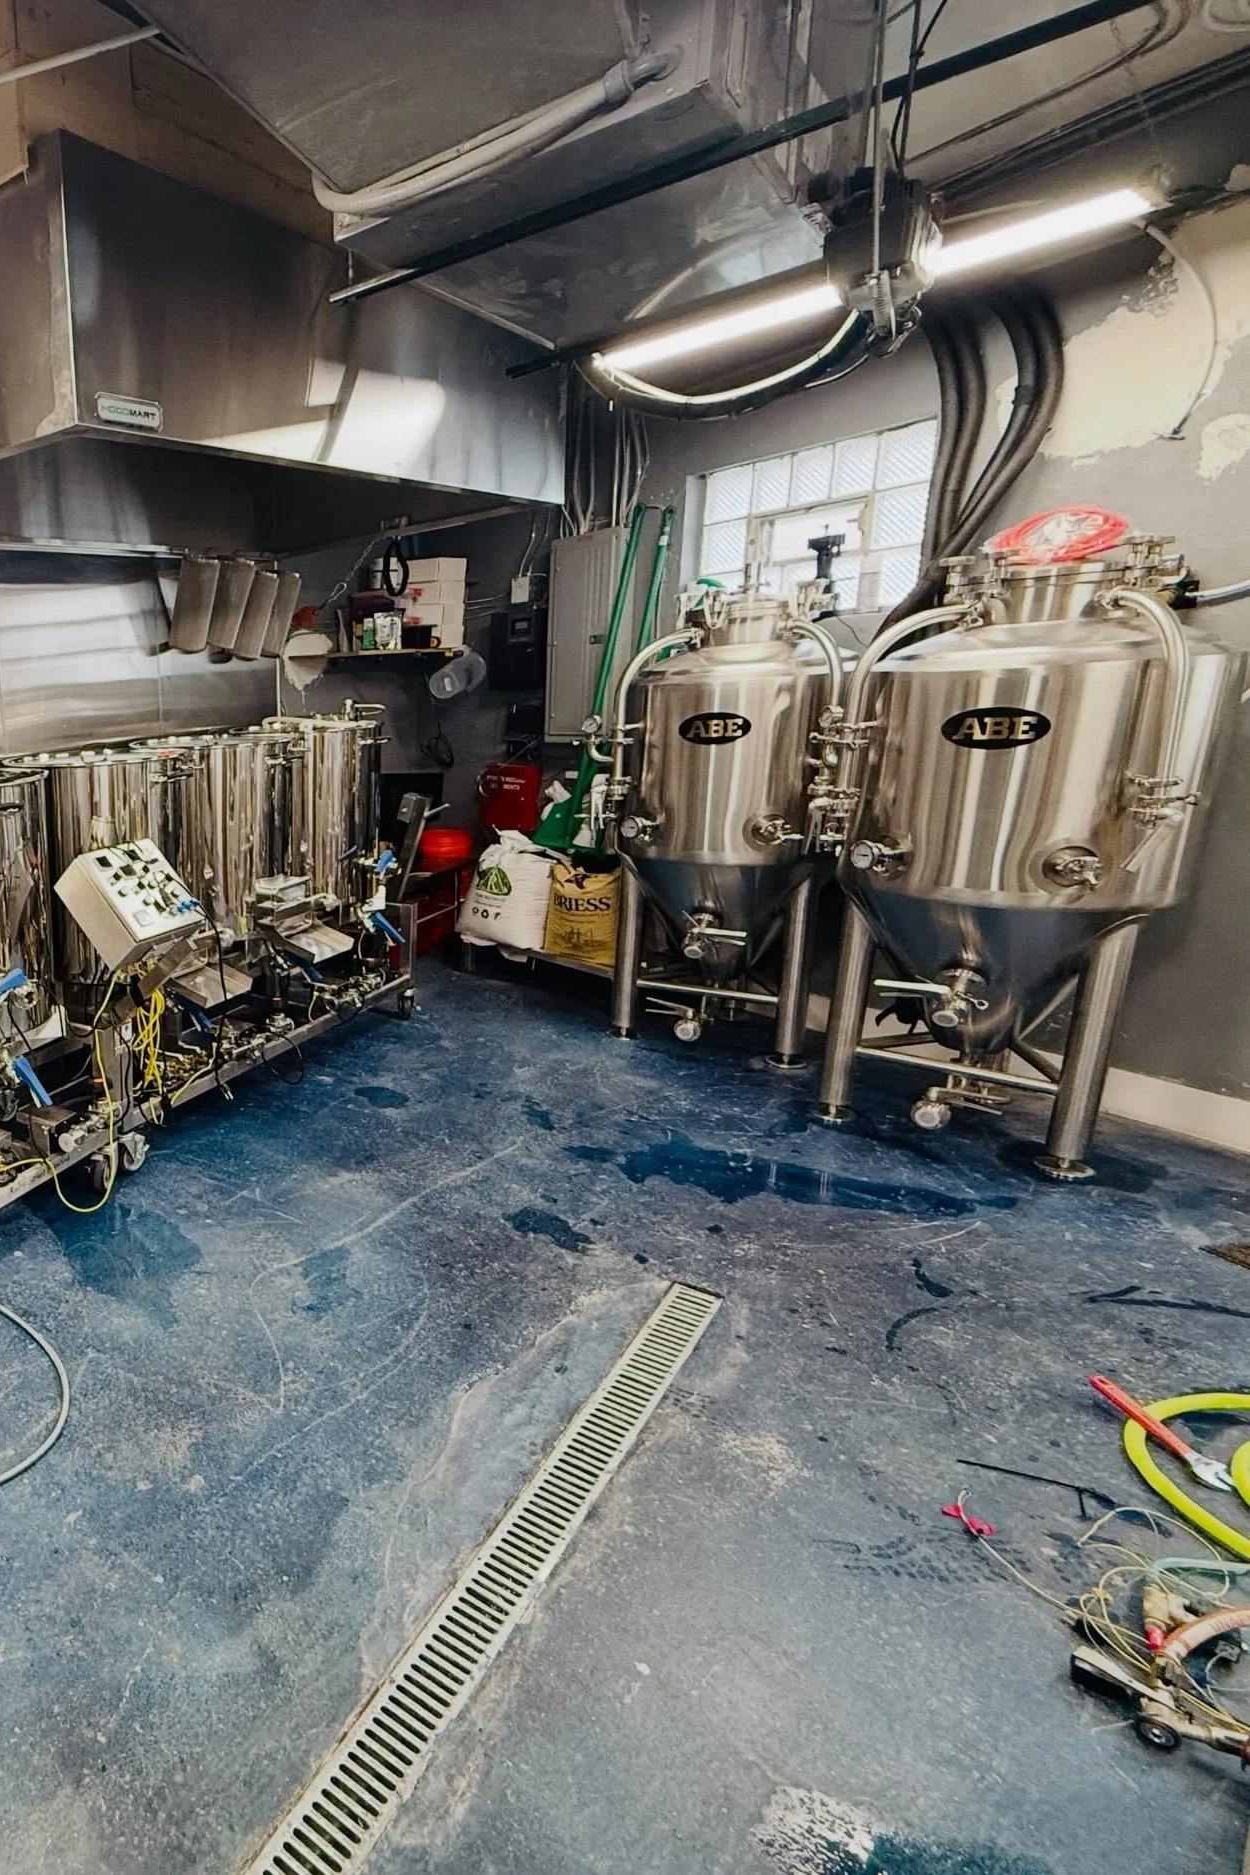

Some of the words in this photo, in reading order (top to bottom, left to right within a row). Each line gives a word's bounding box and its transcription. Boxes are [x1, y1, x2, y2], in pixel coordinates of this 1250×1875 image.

[686, 718, 743, 738] ABE
[951, 716, 1039, 740] ABE
[554, 893, 612, 912] BRIESS
